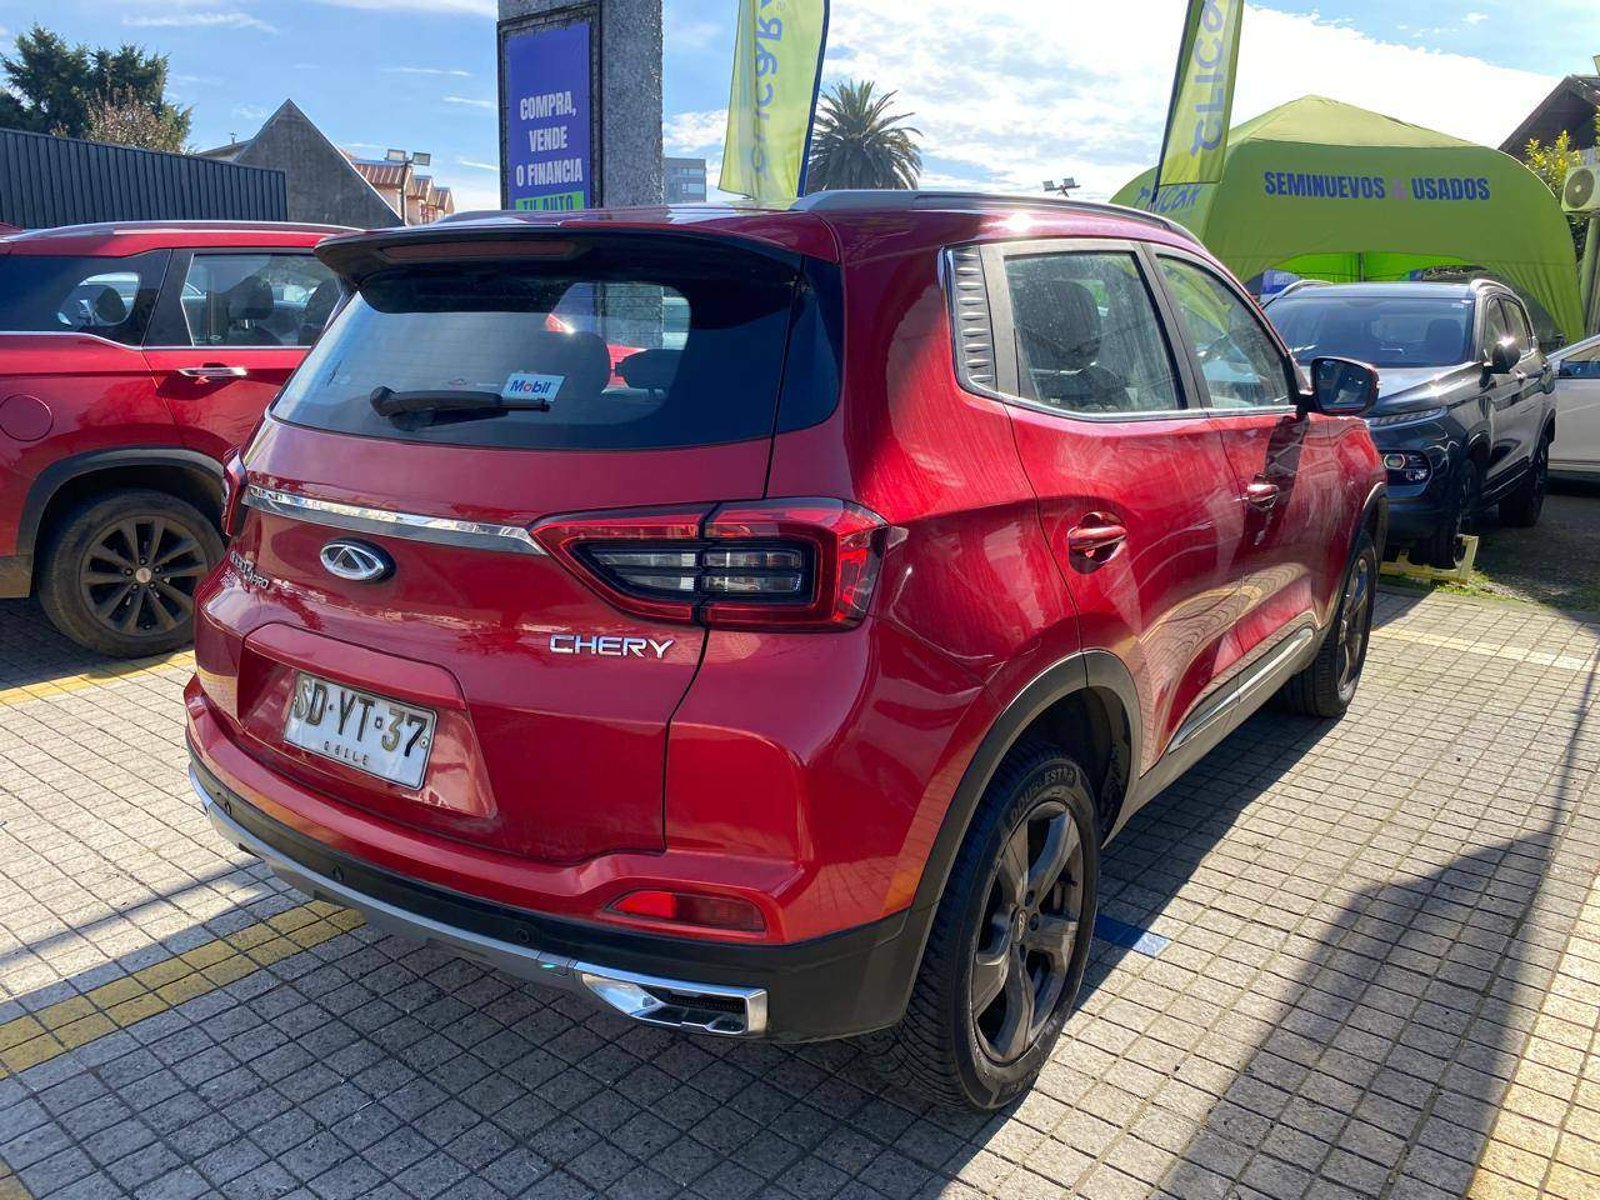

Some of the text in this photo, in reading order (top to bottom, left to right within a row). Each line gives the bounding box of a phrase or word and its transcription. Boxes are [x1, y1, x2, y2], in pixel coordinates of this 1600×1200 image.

[520, 91, 577, 120] COMPRA,
[529, 126, 568, 152] VENDE
[516, 158, 583, 187] O FINANCIA
[1264, 171, 1386, 199] SEMINUEVOS
[1411, 177, 1491, 201] USADOS
[510, 379, 552, 394] Mobil
[549, 634, 674, 659] CHERY
